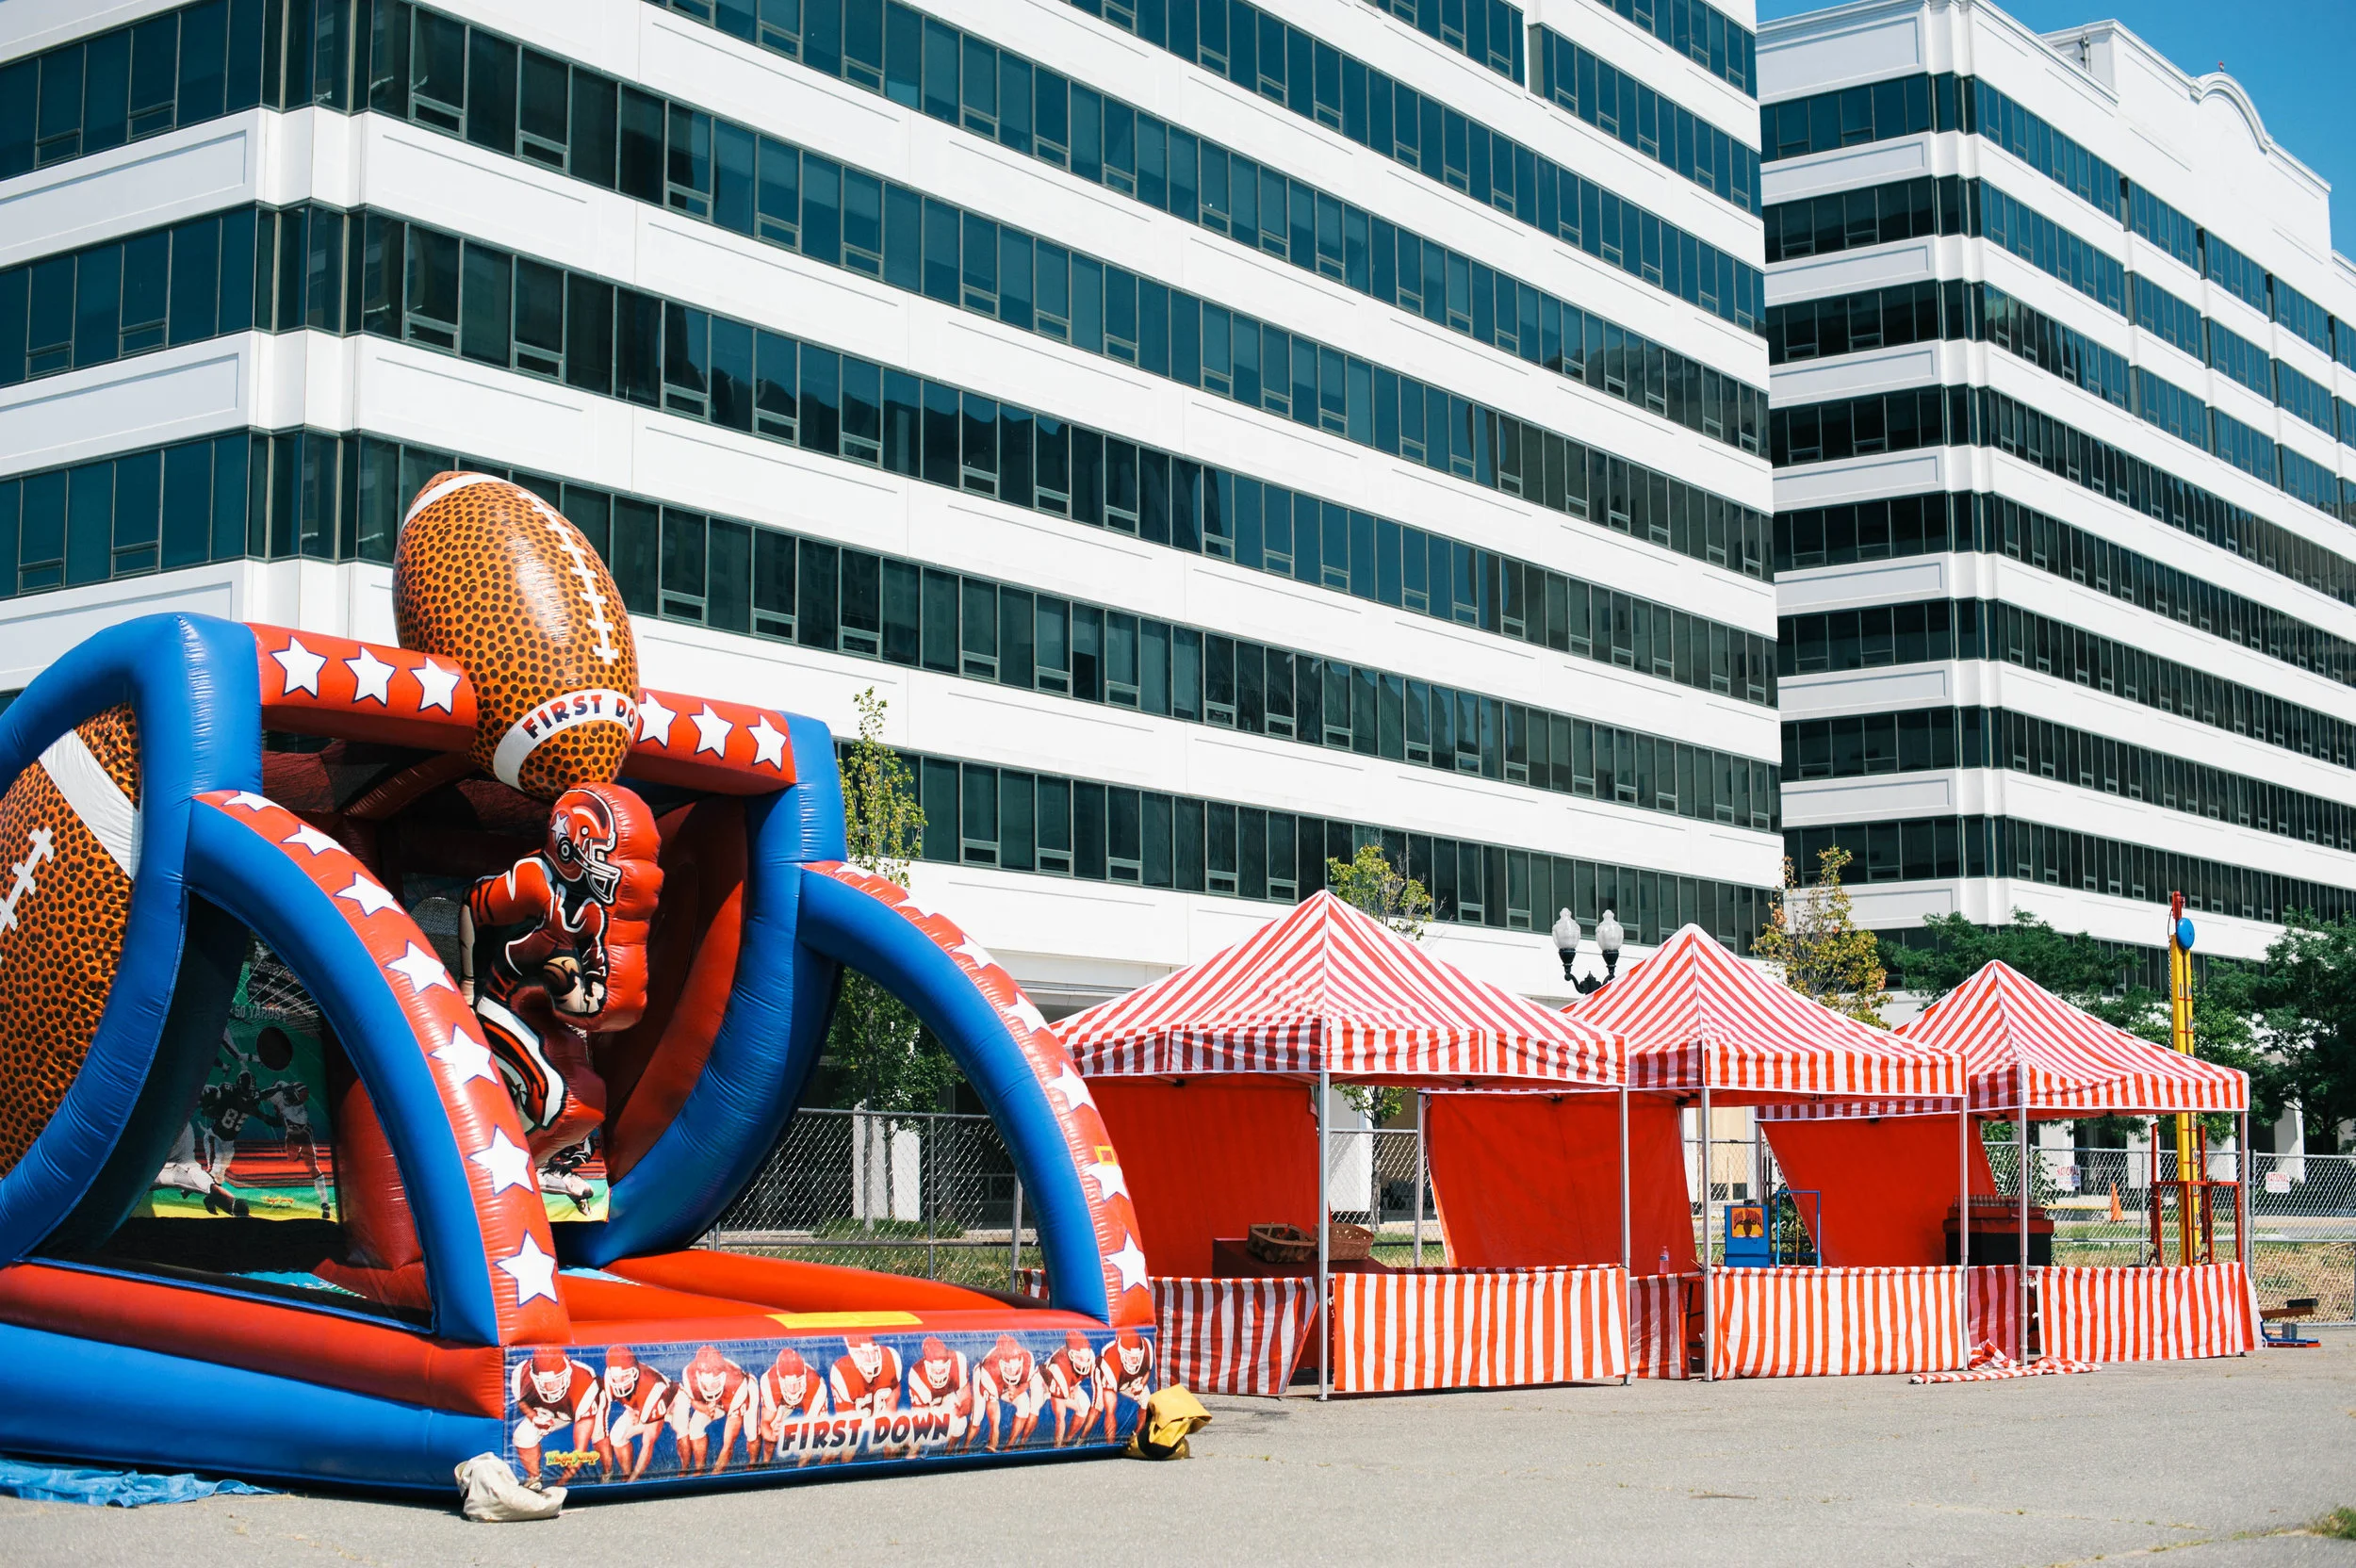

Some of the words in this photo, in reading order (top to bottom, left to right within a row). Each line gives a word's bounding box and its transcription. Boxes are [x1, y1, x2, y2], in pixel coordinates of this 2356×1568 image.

[522, 694, 602, 740] FIRST
[615, 698, 635, 730] DO
[234, 1004, 247, 1019] 50
[782, 1417, 862, 1451] FIRST
[873, 1413, 950, 1445] DOWN
